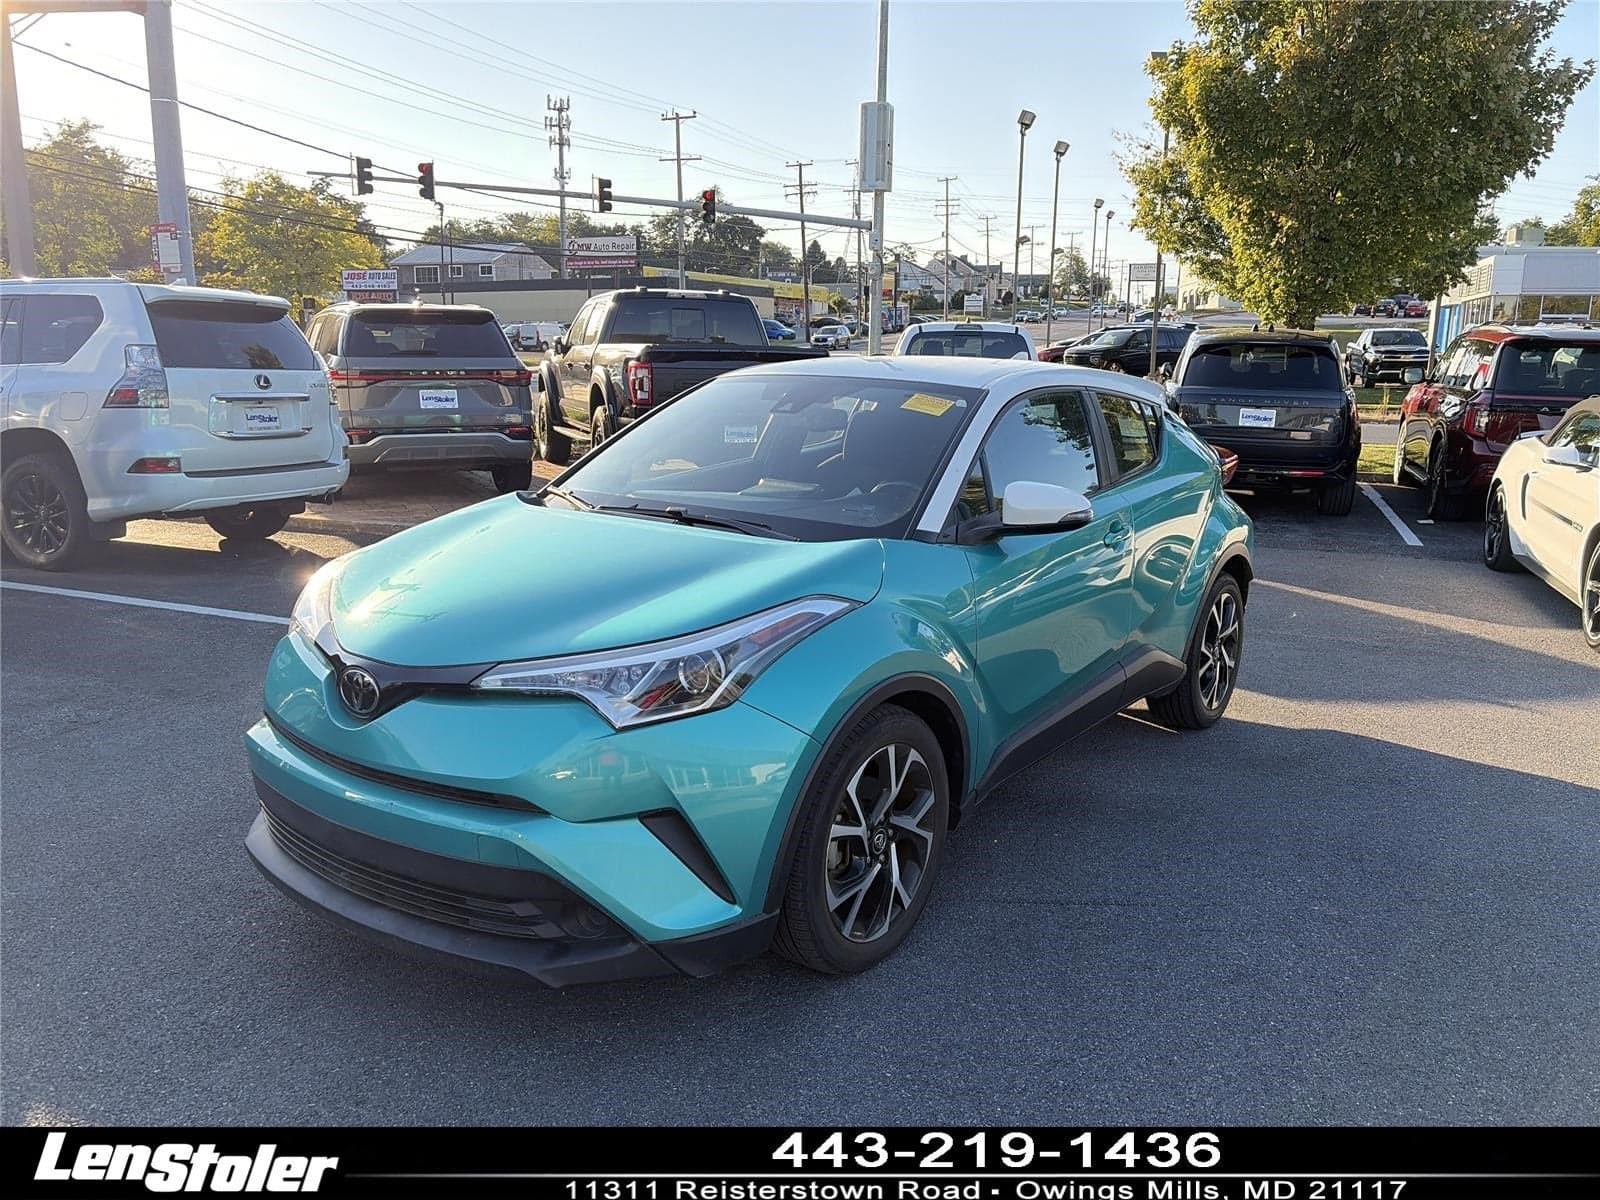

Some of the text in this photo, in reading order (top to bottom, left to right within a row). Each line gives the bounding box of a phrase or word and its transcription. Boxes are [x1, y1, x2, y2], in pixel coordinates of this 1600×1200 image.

[594, 243, 609, 251] Auto
[612, 241, 635, 250] Repair
[368, 272, 381, 280] AUTO
[382, 272, 396, 280] SALES
